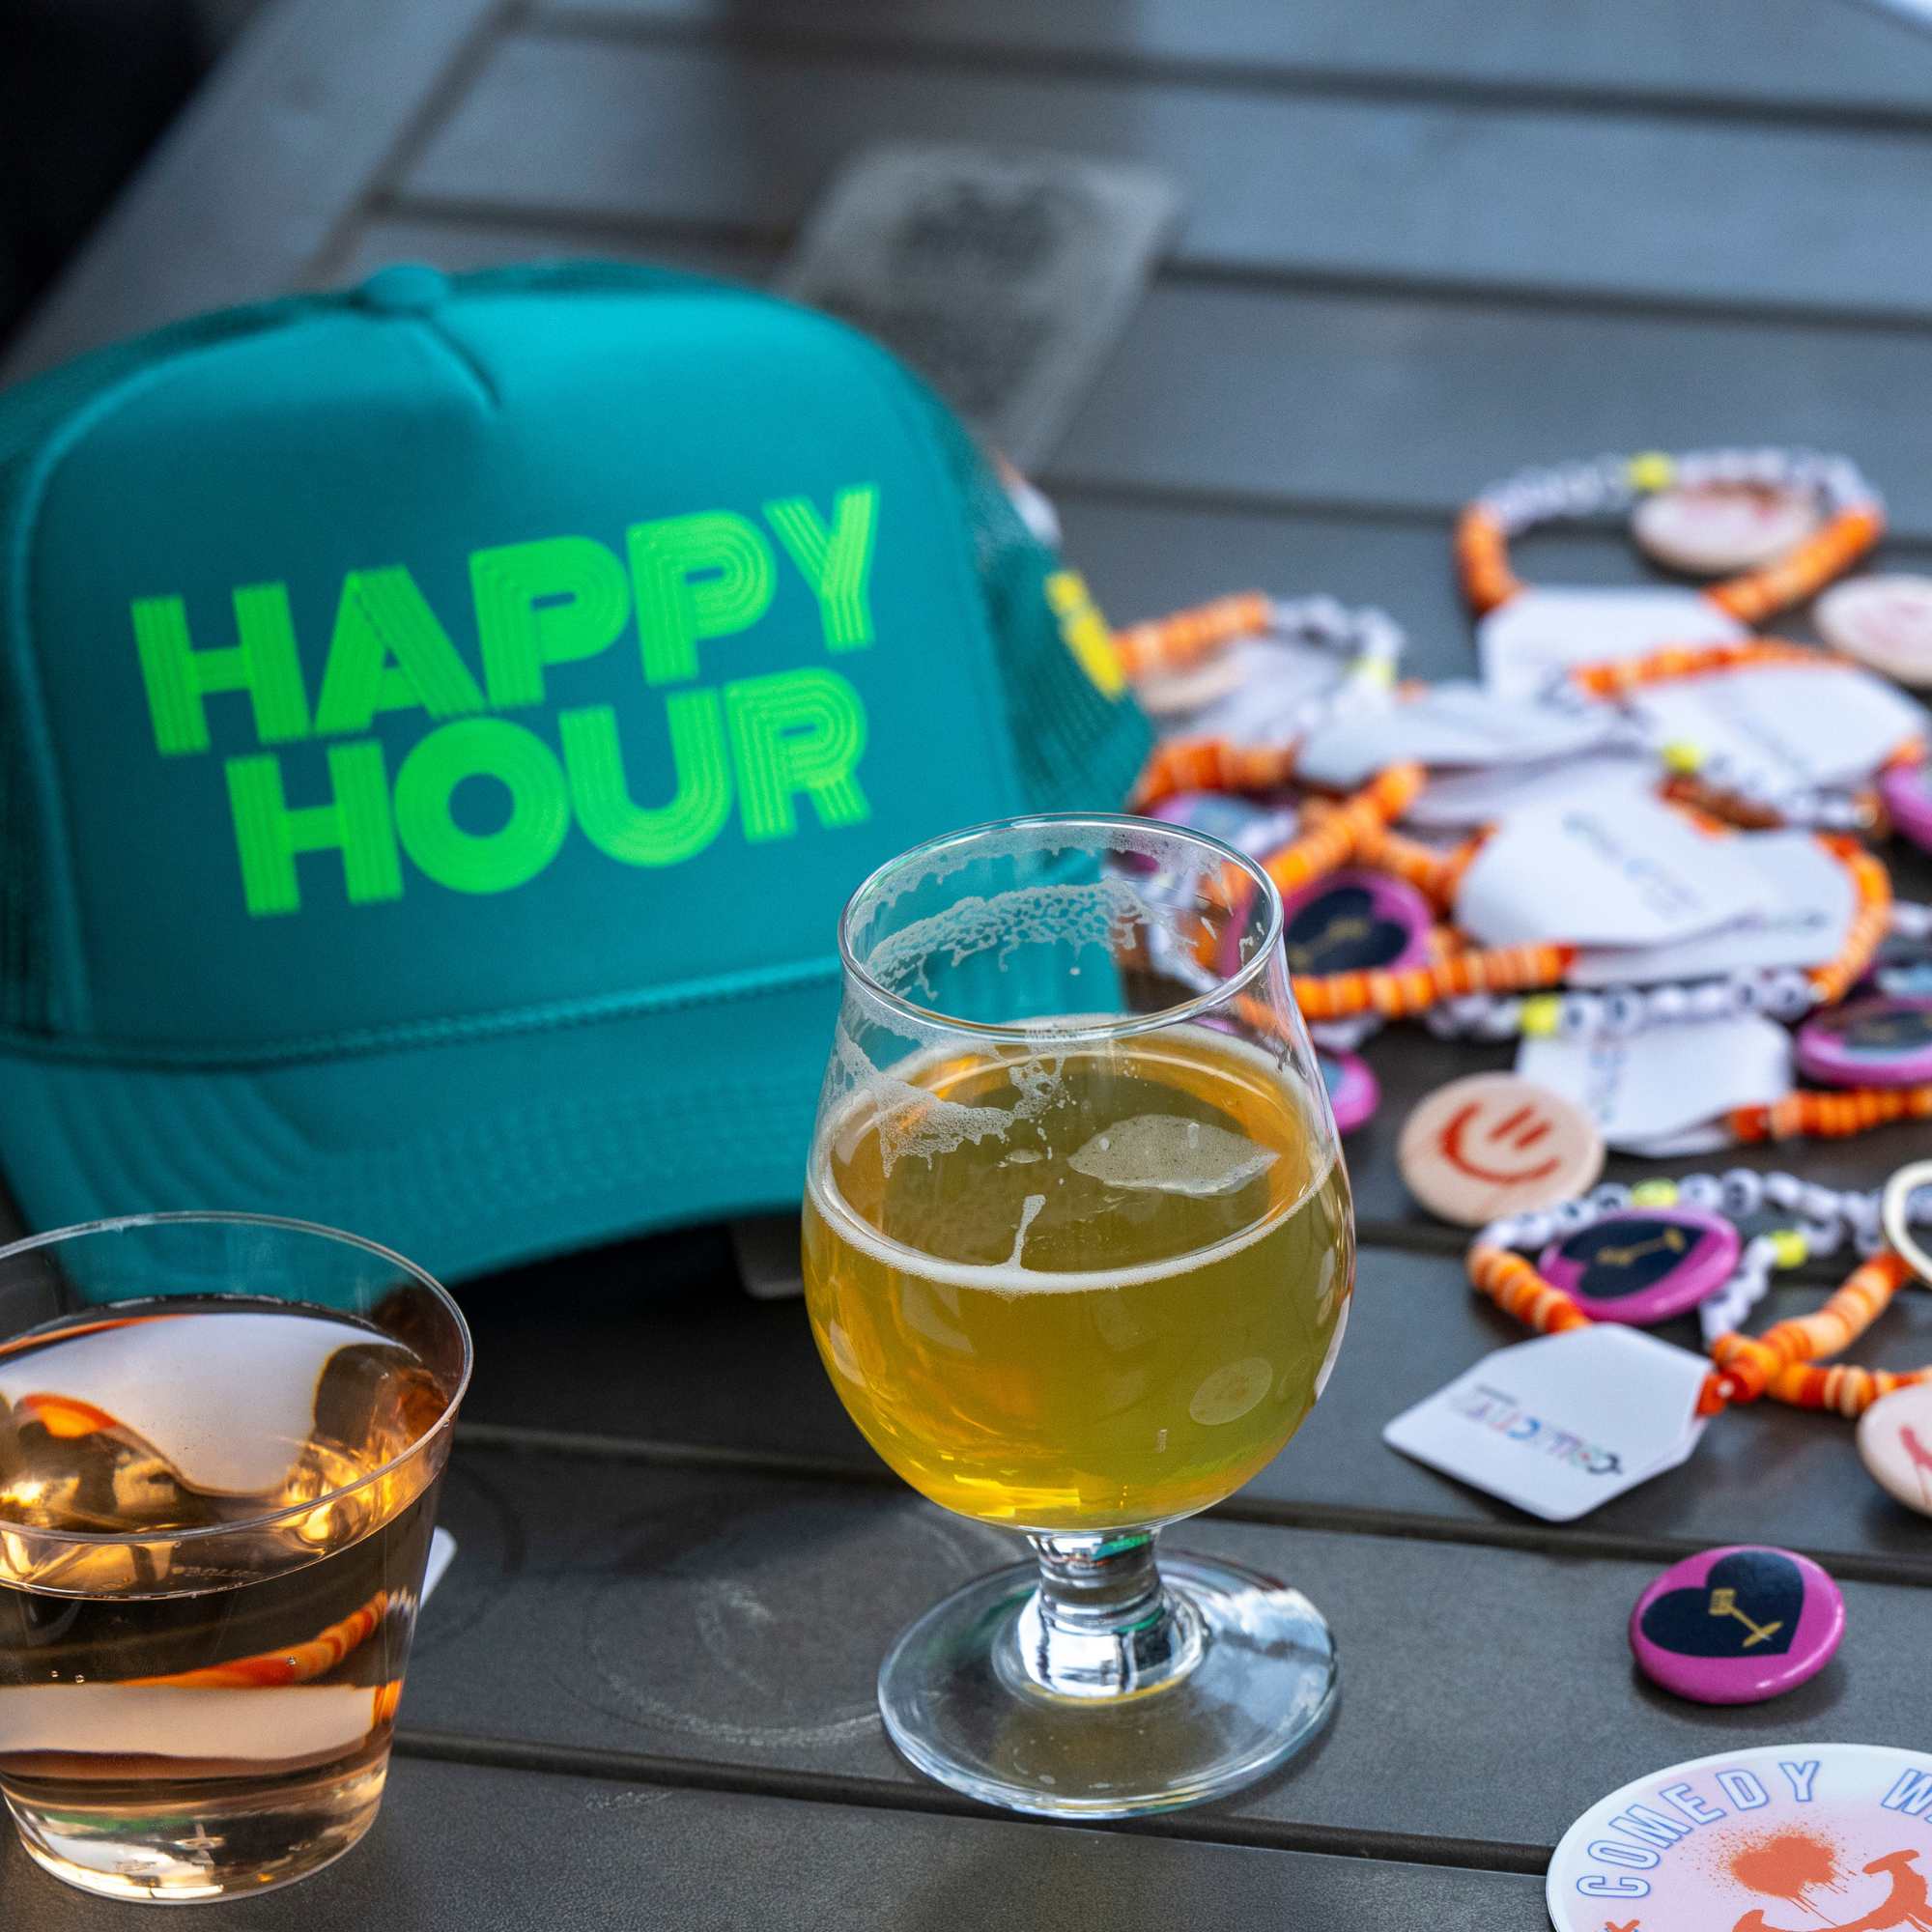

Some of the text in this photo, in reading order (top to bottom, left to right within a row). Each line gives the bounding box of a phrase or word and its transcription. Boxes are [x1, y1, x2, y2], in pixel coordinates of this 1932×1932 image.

[130, 484, 881, 755] HAPPY
[225, 667, 871, 917] HOUR
[1577, 1760, 1932, 1899] COMEDY W
